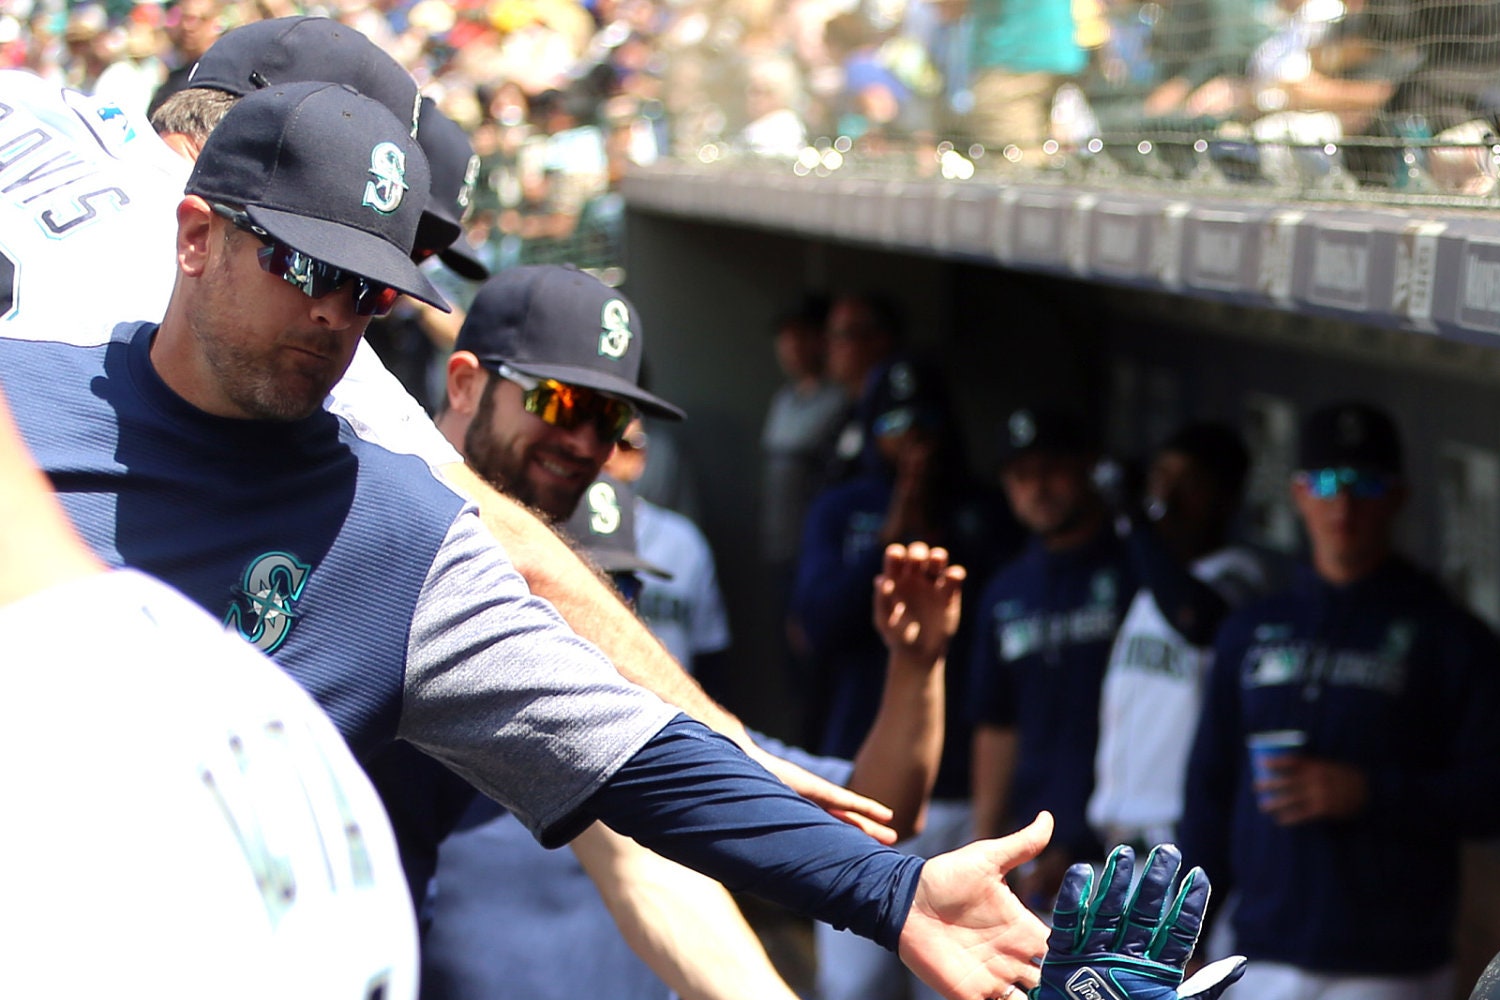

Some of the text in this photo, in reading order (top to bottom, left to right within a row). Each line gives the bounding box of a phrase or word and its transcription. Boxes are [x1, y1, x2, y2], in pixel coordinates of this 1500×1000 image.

[0, 103, 130, 240] AVIS
[362, 142, 409, 216] S
[598, 298, 633, 361] S
[588, 482, 621, 534] S
